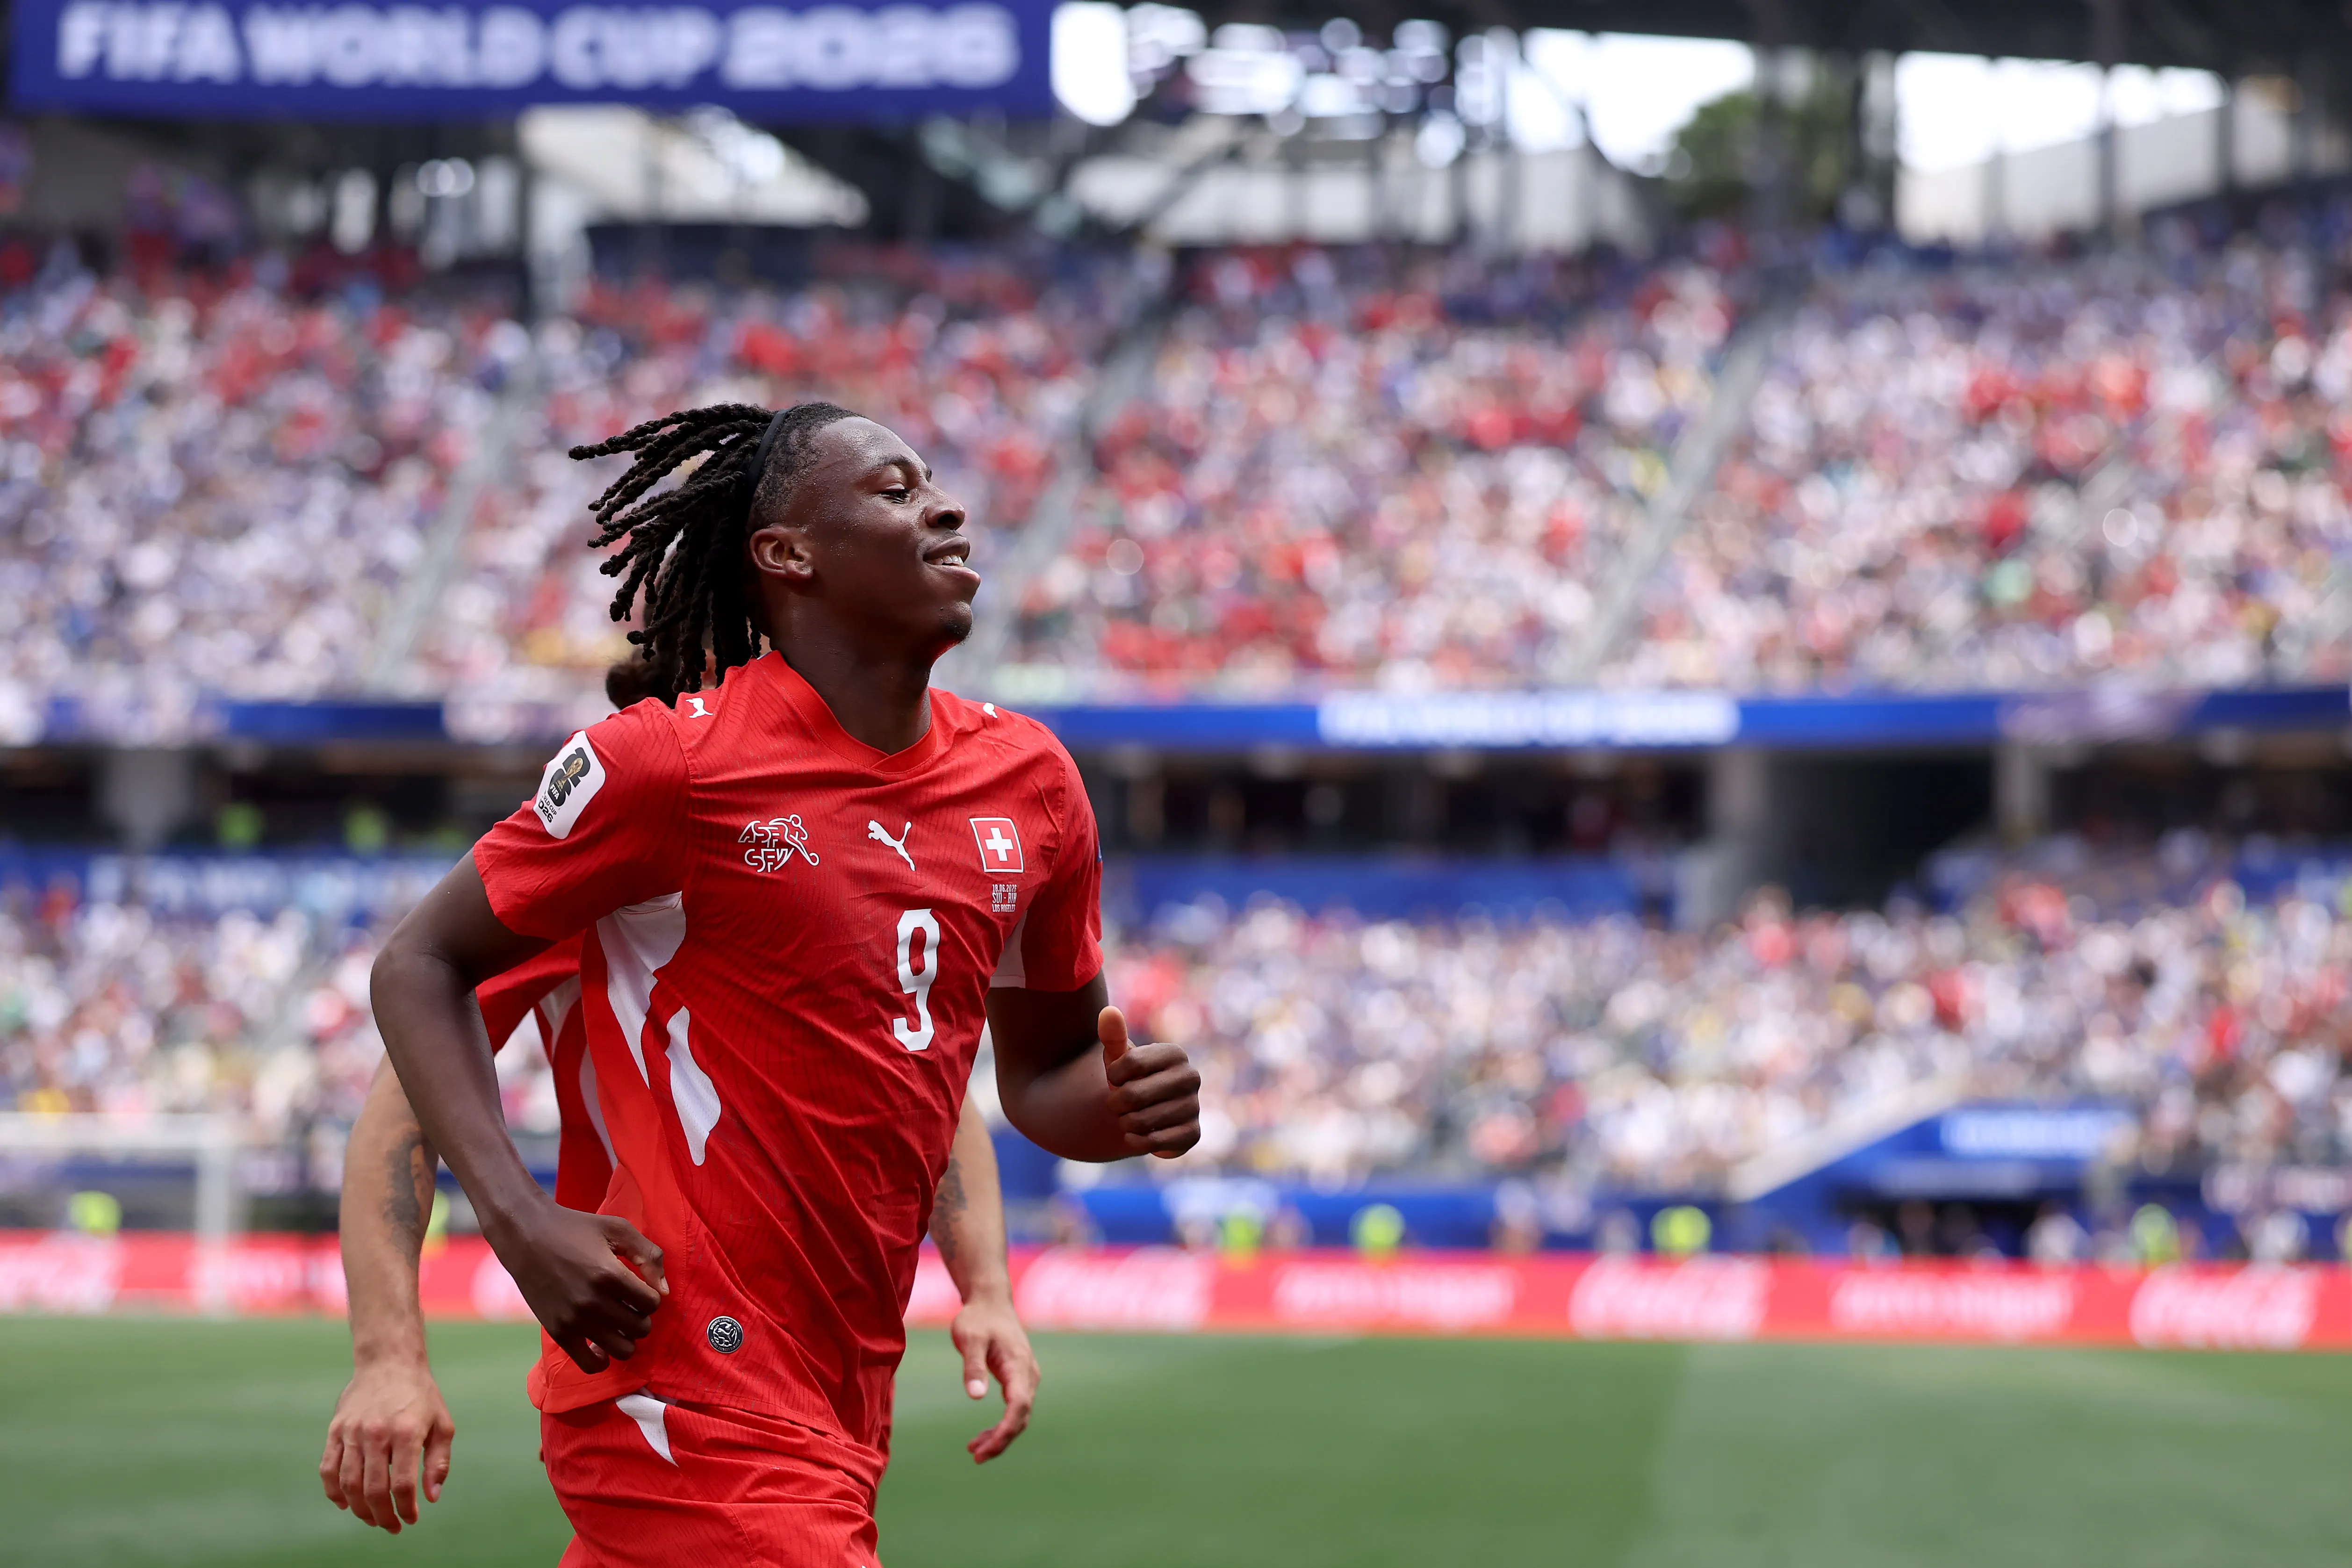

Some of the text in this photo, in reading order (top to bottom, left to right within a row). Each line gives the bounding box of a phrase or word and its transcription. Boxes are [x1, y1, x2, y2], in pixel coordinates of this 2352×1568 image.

[57, 2, 1019, 91] FIFA WORLD CUP 2026
[550, 784, 560, 800] FIFA
[992, 892, 1002, 903] SUI
[1007, 892, 1017, 903] BIH
[992, 904, 1000, 912] LOS
[893, 908, 940, 1051] 9
